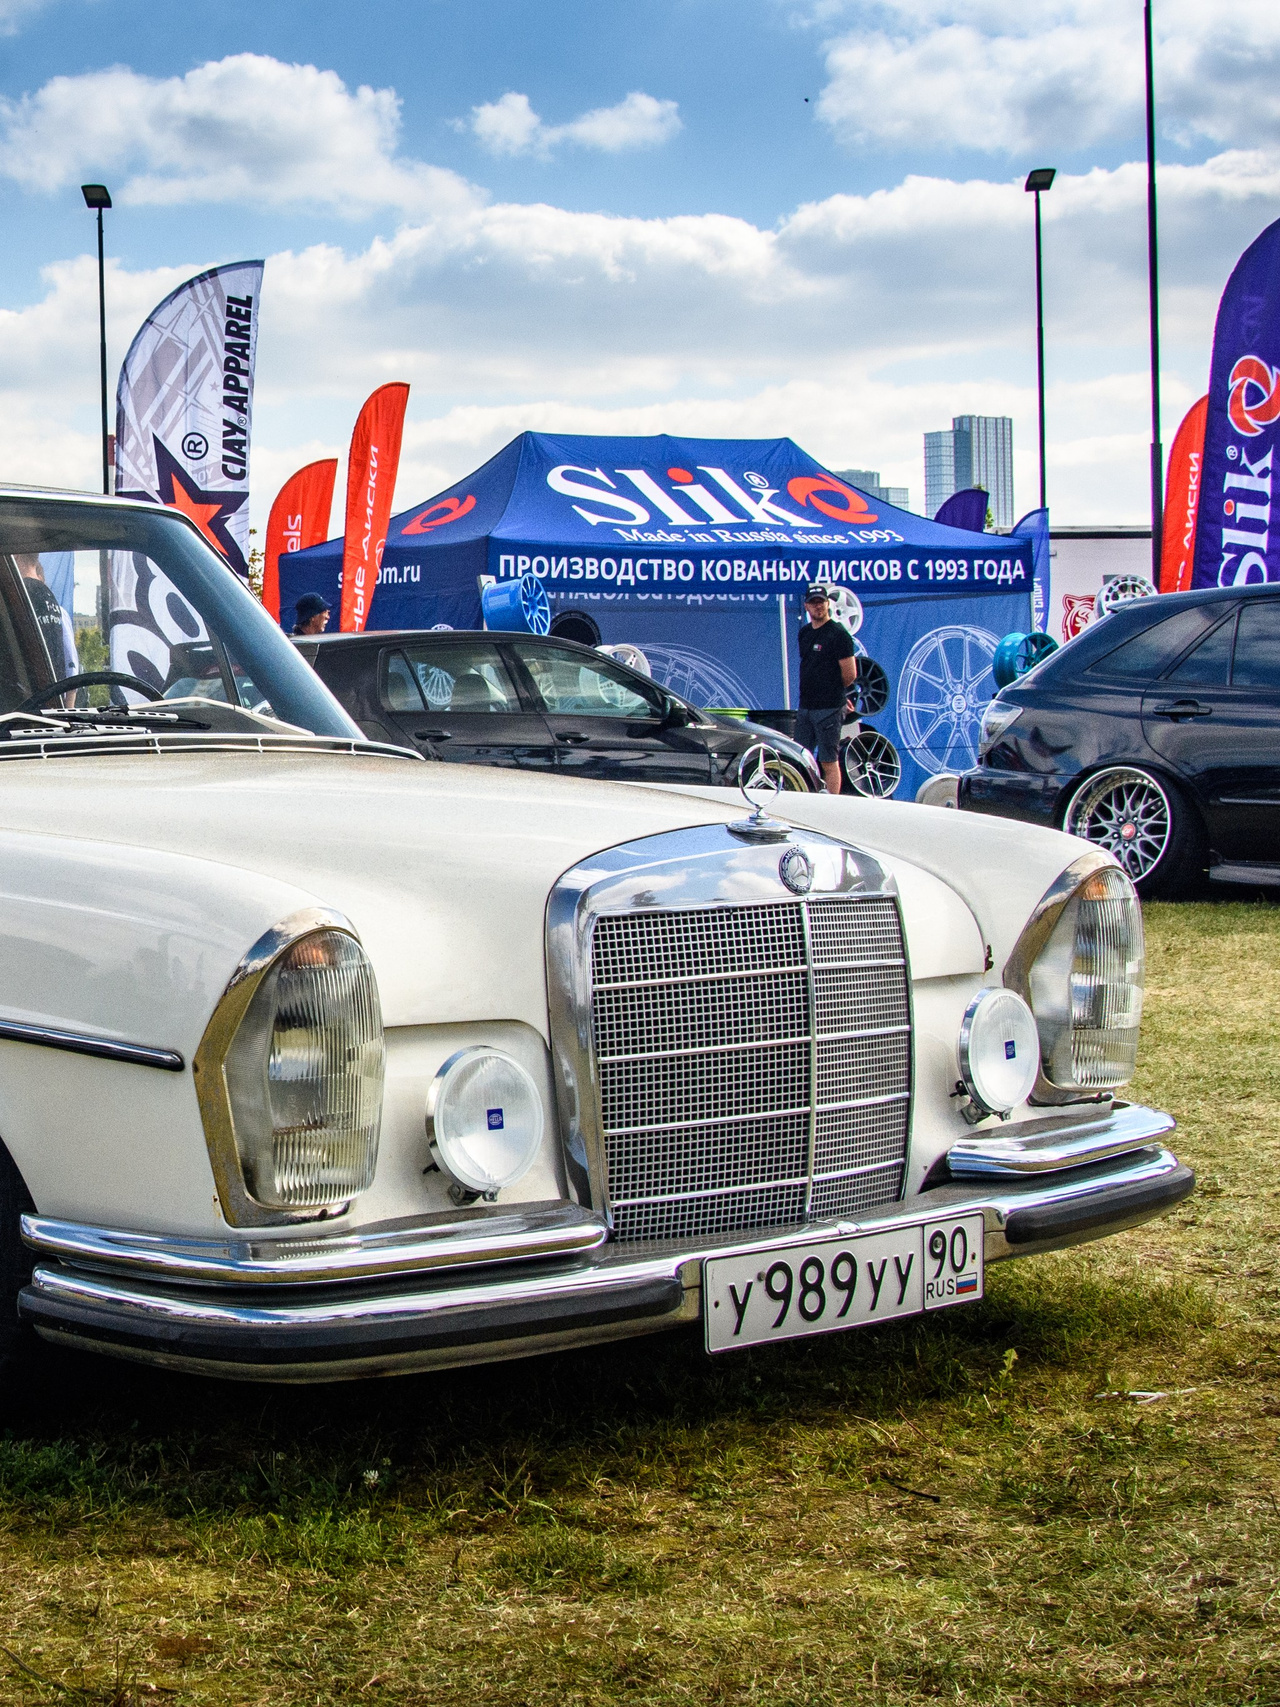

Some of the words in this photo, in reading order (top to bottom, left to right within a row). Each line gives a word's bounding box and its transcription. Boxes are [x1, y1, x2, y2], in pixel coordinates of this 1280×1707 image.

[222, 295, 253, 416] APPAREL
[613, 528, 685, 543] Made
[685, 528, 717, 543] in
[714, 528, 793, 543] Russia
[792, 529, 849, 545] since
[849, 529, 905, 545] 1993
[1218, 443, 1274, 588] Slik
[499, 554, 695, 586] ПРОИЗВОДСТВО
[701, 559, 811, 582] КОВАНЫХ
[815, 559, 902, 584] ДИСКОВ
[907, 559, 920, 581] С
[924, 559, 969, 582] 1993
[973, 559, 1026, 585] ГОДА
[928, 1225, 968, 1279] 90
[926, 1278, 956, 1301] RUS
